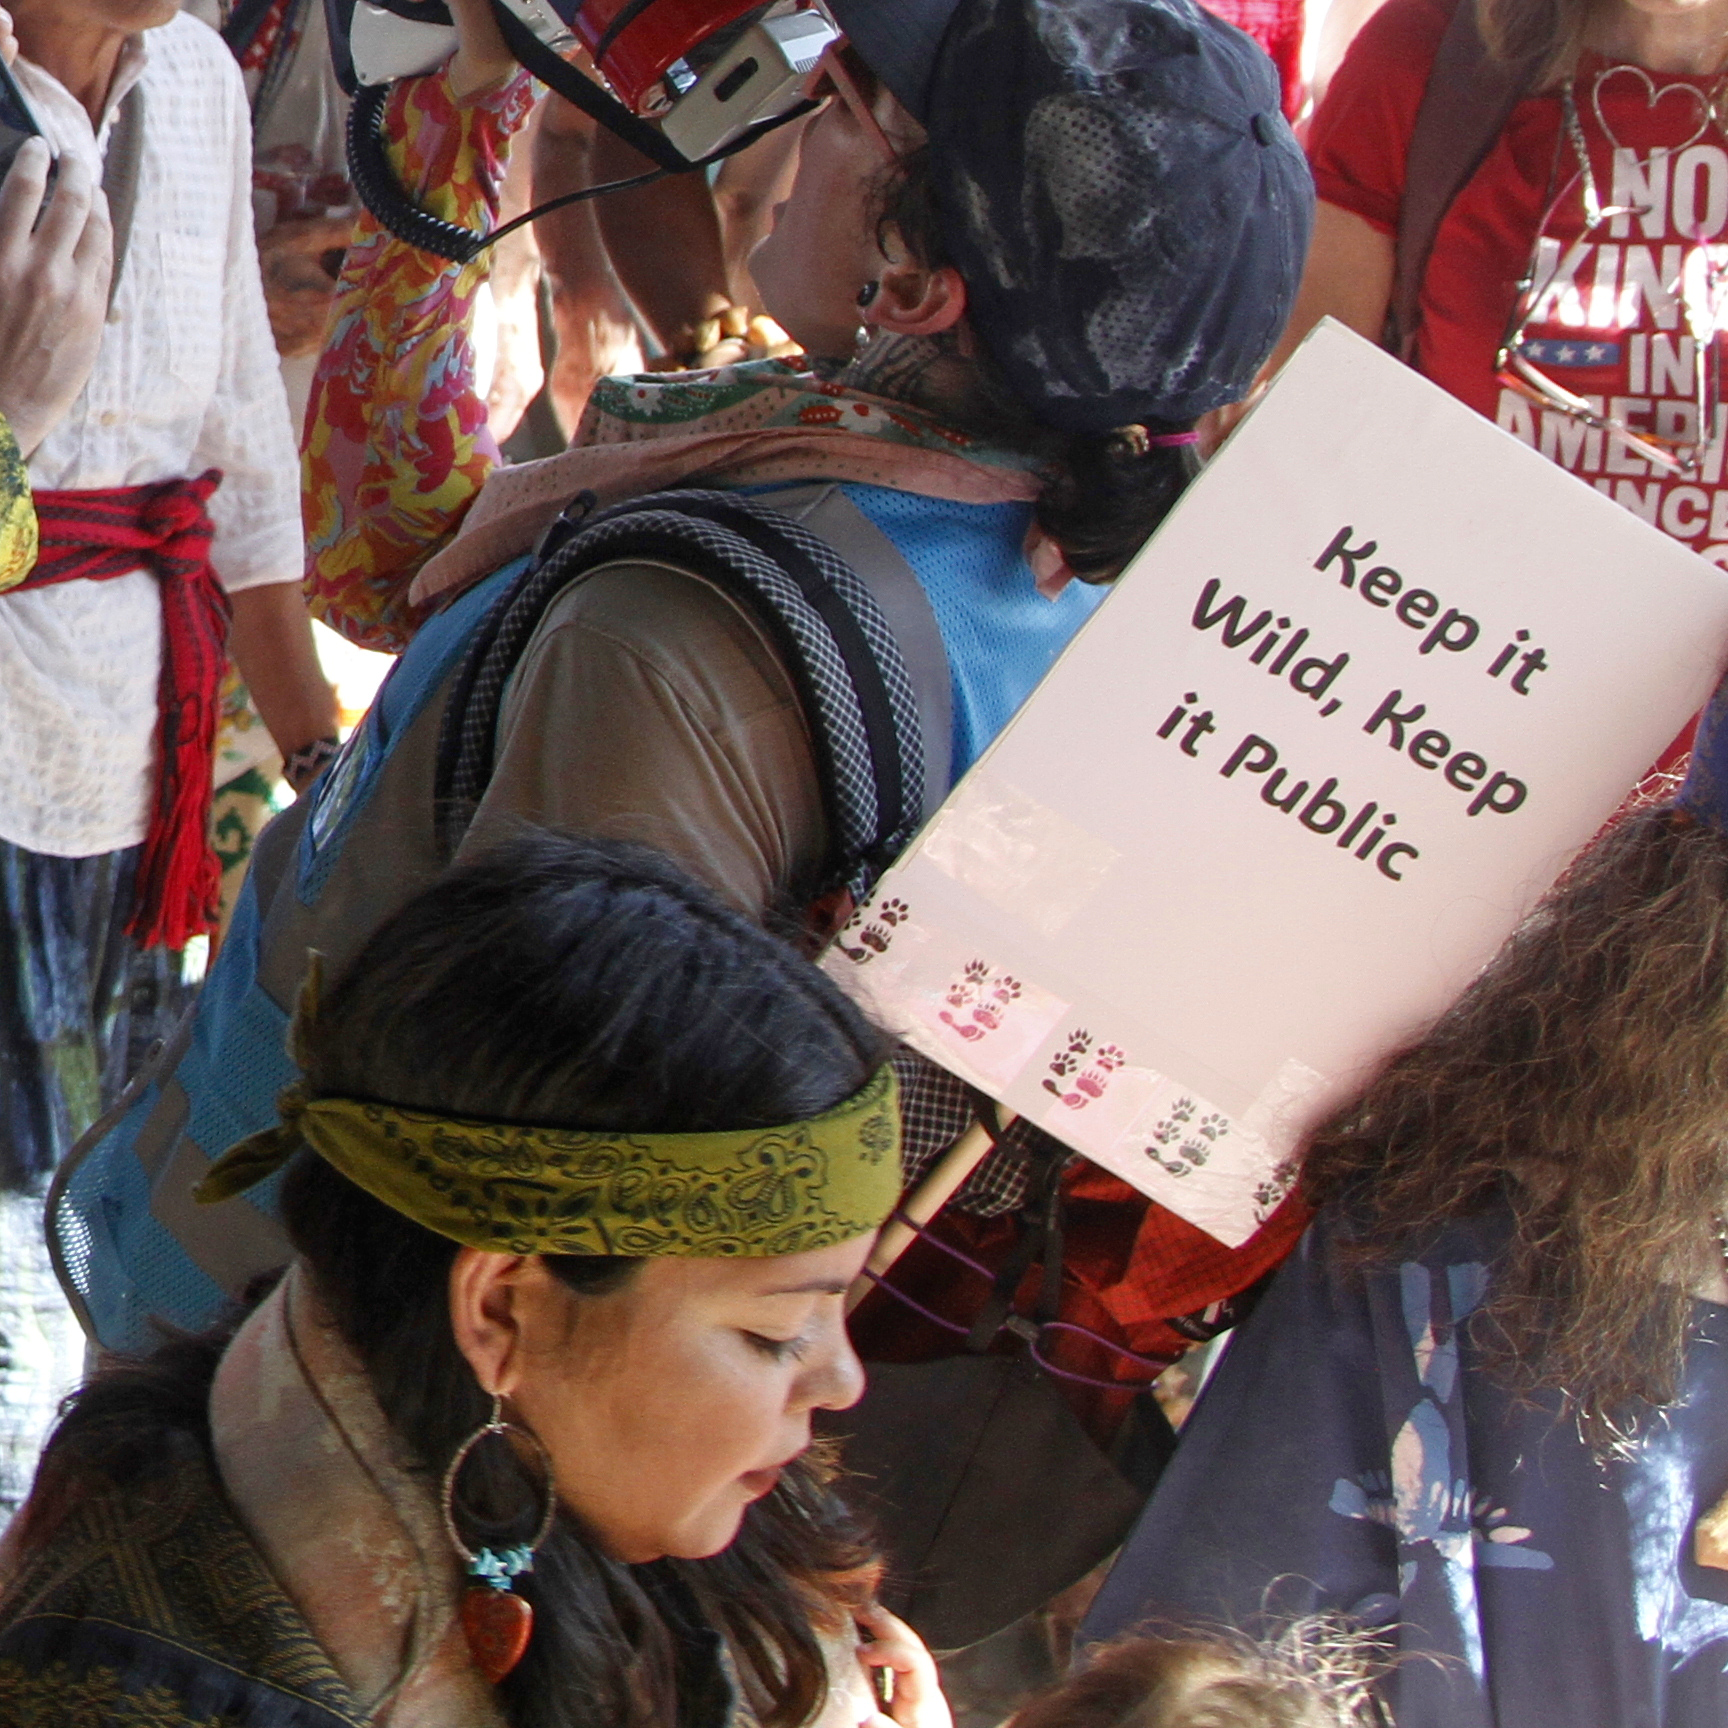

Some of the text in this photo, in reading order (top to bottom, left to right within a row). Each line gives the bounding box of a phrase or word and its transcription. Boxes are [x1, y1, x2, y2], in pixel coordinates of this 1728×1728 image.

[1610, 144, 1728, 240] NO
[1628, 334, 1697, 397] IN
[1313, 525, 1551, 697] Keep it
[1190, 577, 1530, 818] Wild, Keep
[1156, 691, 1422, 883] it Public
